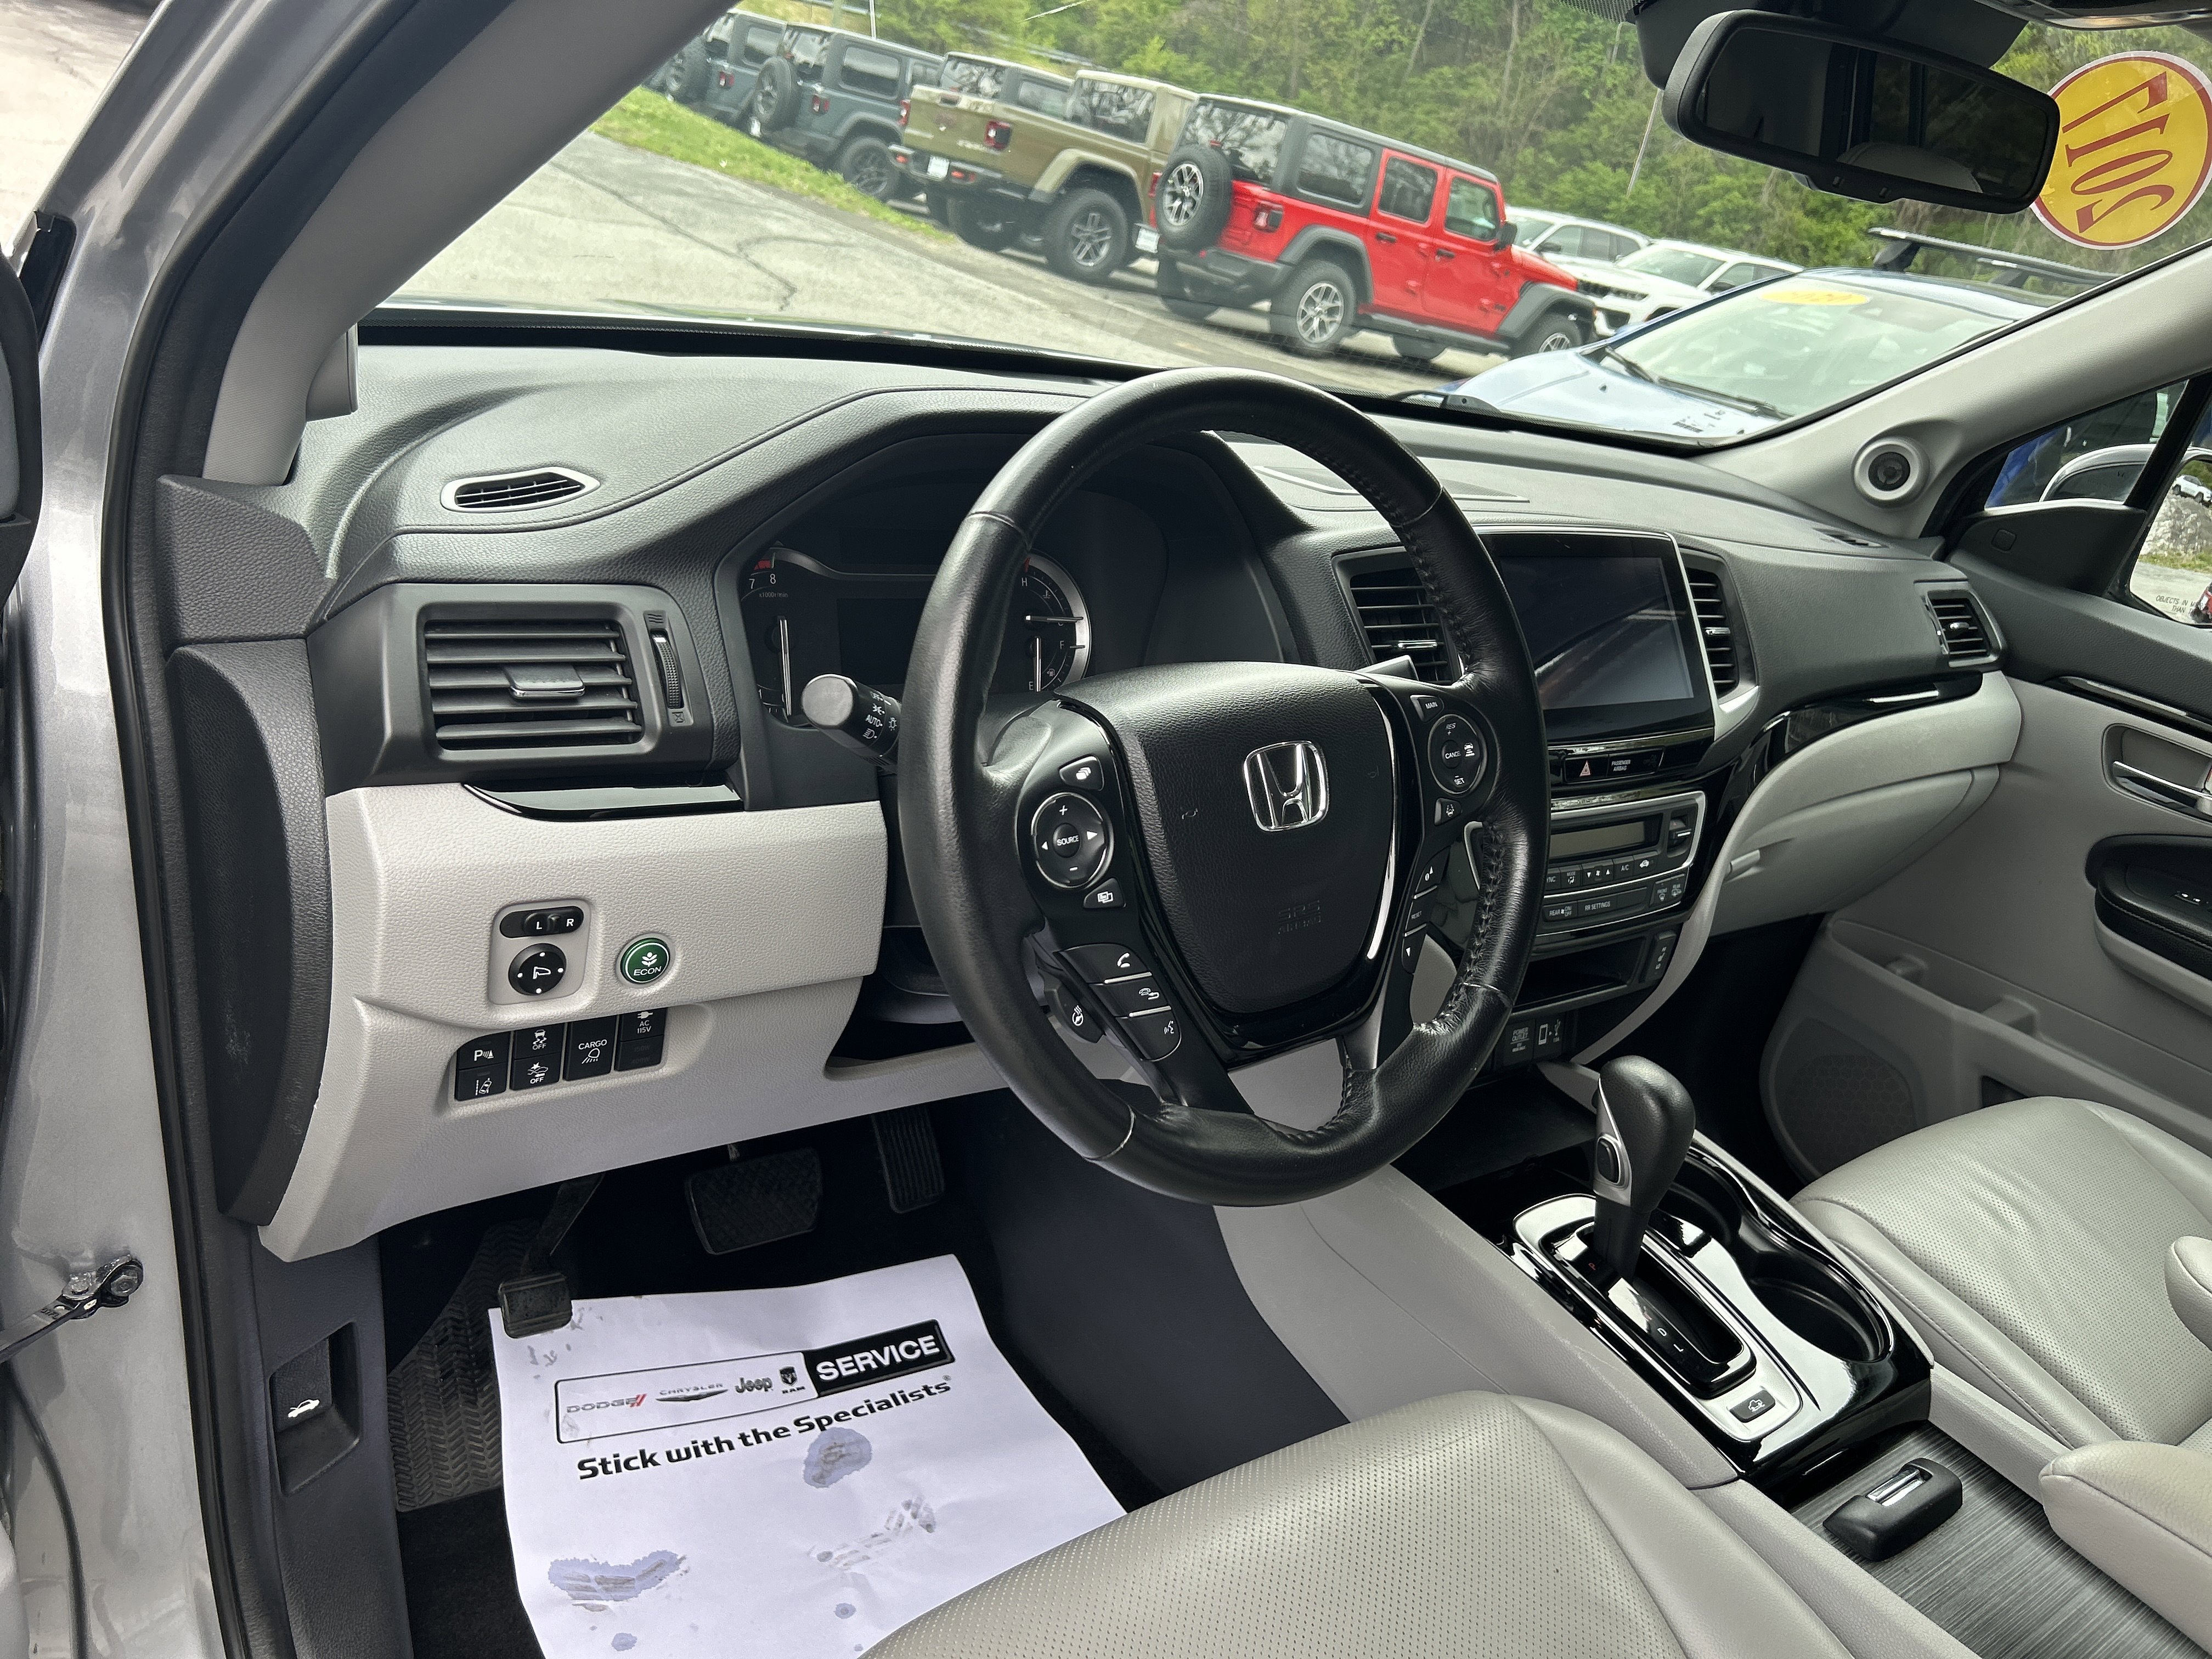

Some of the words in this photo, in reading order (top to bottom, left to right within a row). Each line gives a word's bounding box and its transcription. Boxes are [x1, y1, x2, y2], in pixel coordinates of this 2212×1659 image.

[749, 578, 755, 589] 7
[770, 573, 776, 584] 8
[1022, 577, 1028, 586] H
[2155, 595, 2180, 605] OBJECTS
[1059, 641, 1064, 650] F
[1029, 681, 1034, 691] E
[1425, 701, 1438, 709] MAIN
[865, 714, 881, 727] AUTO
[1057, 835, 1079, 846] SOURCE
[535, 921, 543, 930] L
[566, 918, 574, 927] R
[633, 966, 662, 976] ECON
[637, 1025, 652, 1034] 115V
[578, 1039, 607, 1050] CARGO
[1657, 1328, 1667, 1336] D
[1673, 1344, 1684, 1352] L
[816, 1335, 940, 1381] SERVICE
[659, 1383, 724, 1396] CHRYSLER
[735, 1376, 774, 1394] Jeep
[781, 1385, 806, 1395] RAM
[566, 1397, 639, 1413] DODGE
[577, 1449, 662, 1480] Stick
[665, 1435, 735, 1465] with
[737, 1427, 791, 1449] the
[792, 1381, 951, 1434] Specialists
